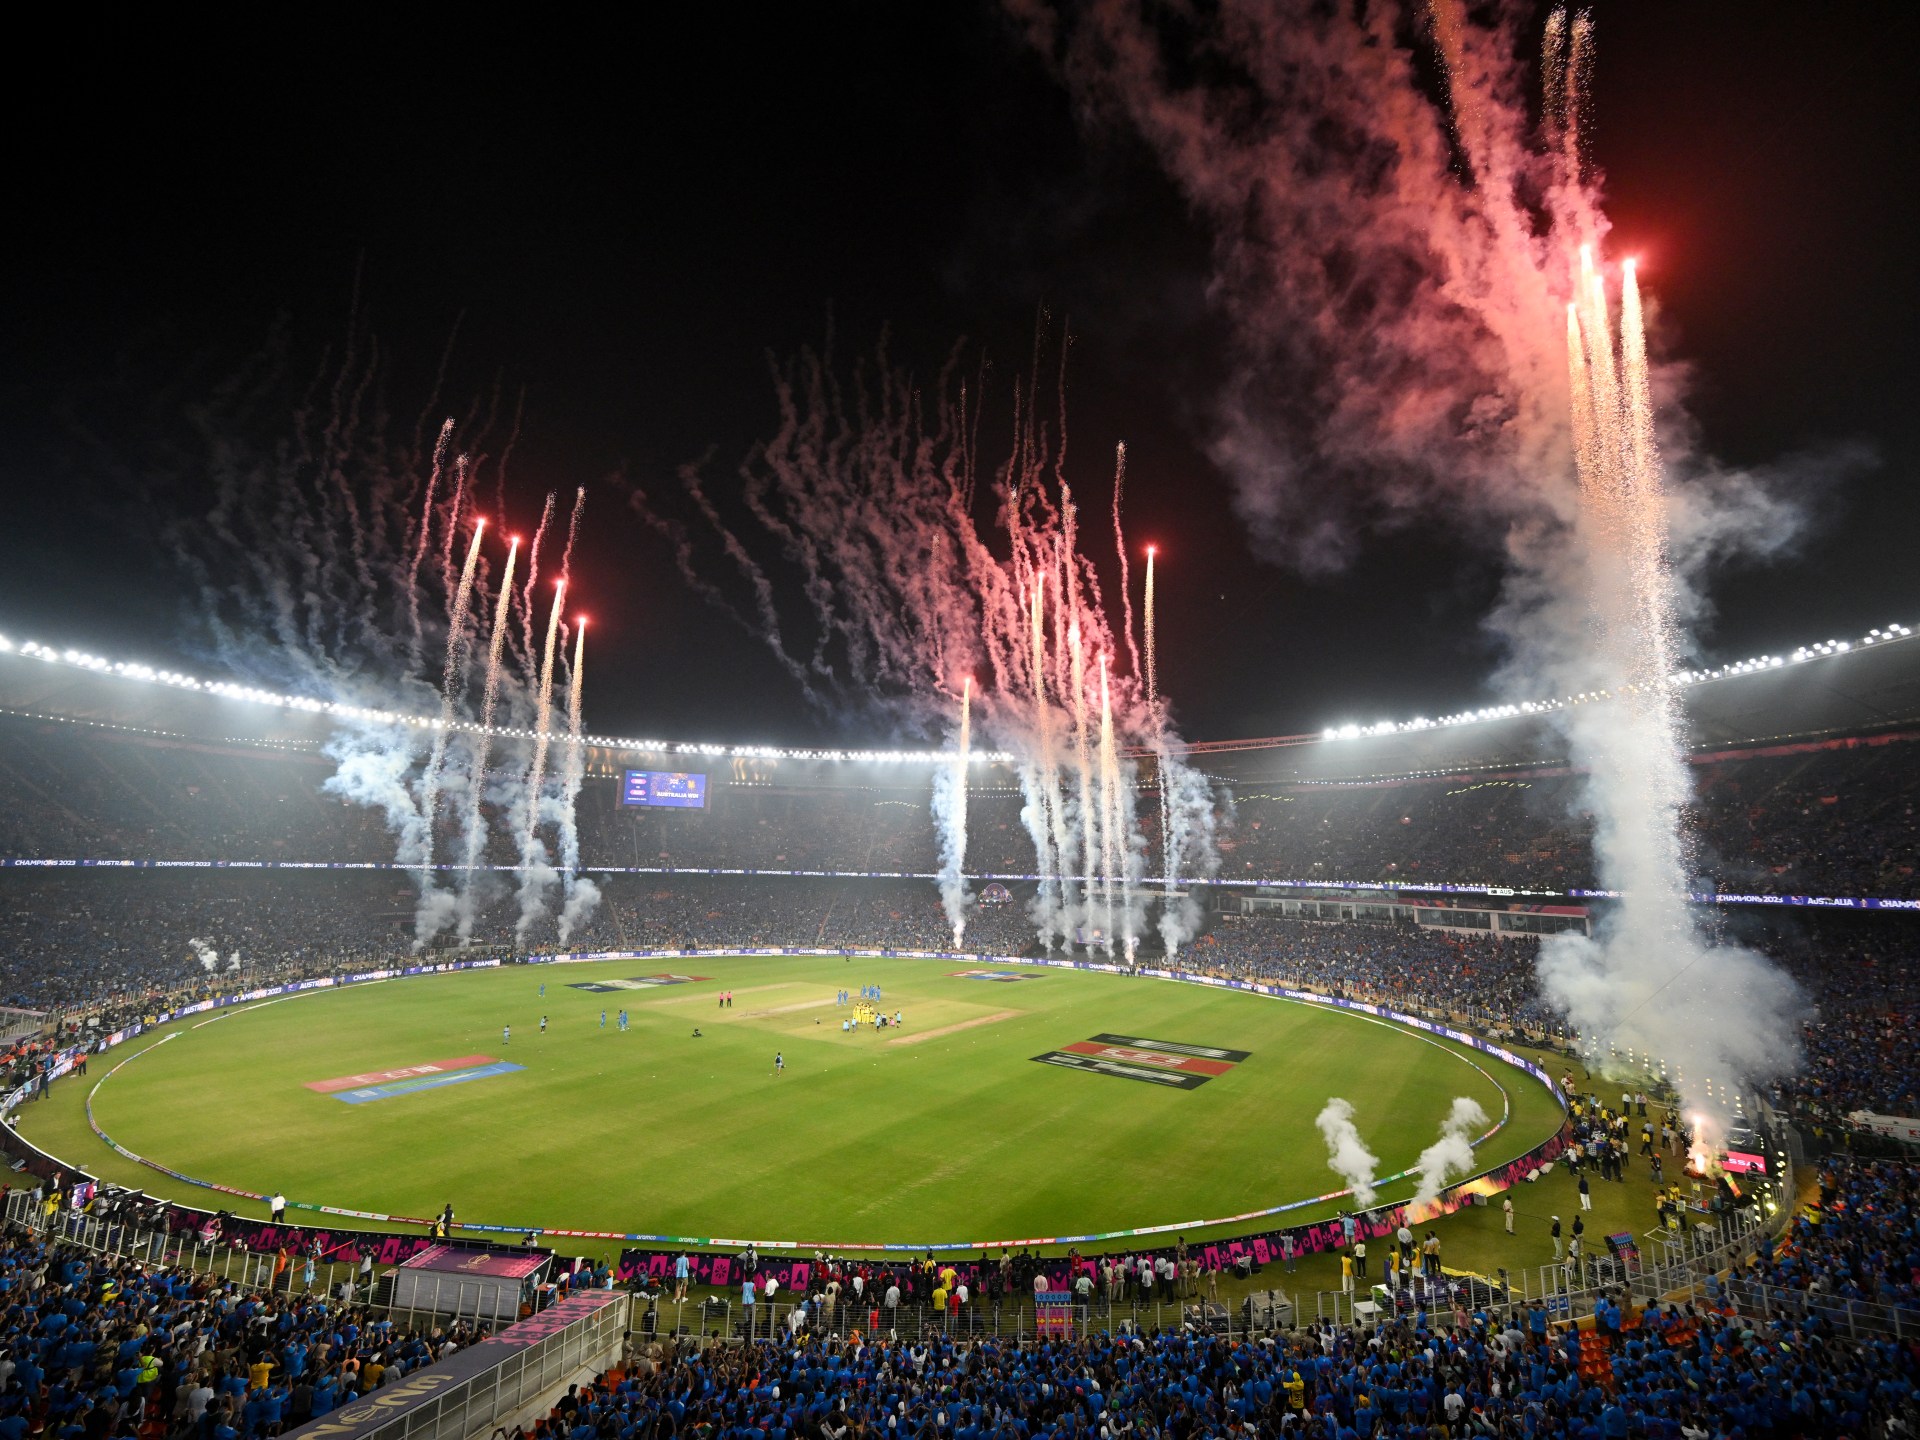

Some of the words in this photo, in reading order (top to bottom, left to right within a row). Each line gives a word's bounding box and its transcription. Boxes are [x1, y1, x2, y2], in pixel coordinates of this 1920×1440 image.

[1807, 897, 1854, 907] AUSTRALIA
[299, 979, 334, 990] AUSTRALIA
[267, 987, 282, 996] 2023
[183, 1000, 214, 1015] AUSTRALIA
[1349, 1002, 1378, 1015] AUSTRALIA
[1446, 1029, 1474, 1045] AUSTRALIA
